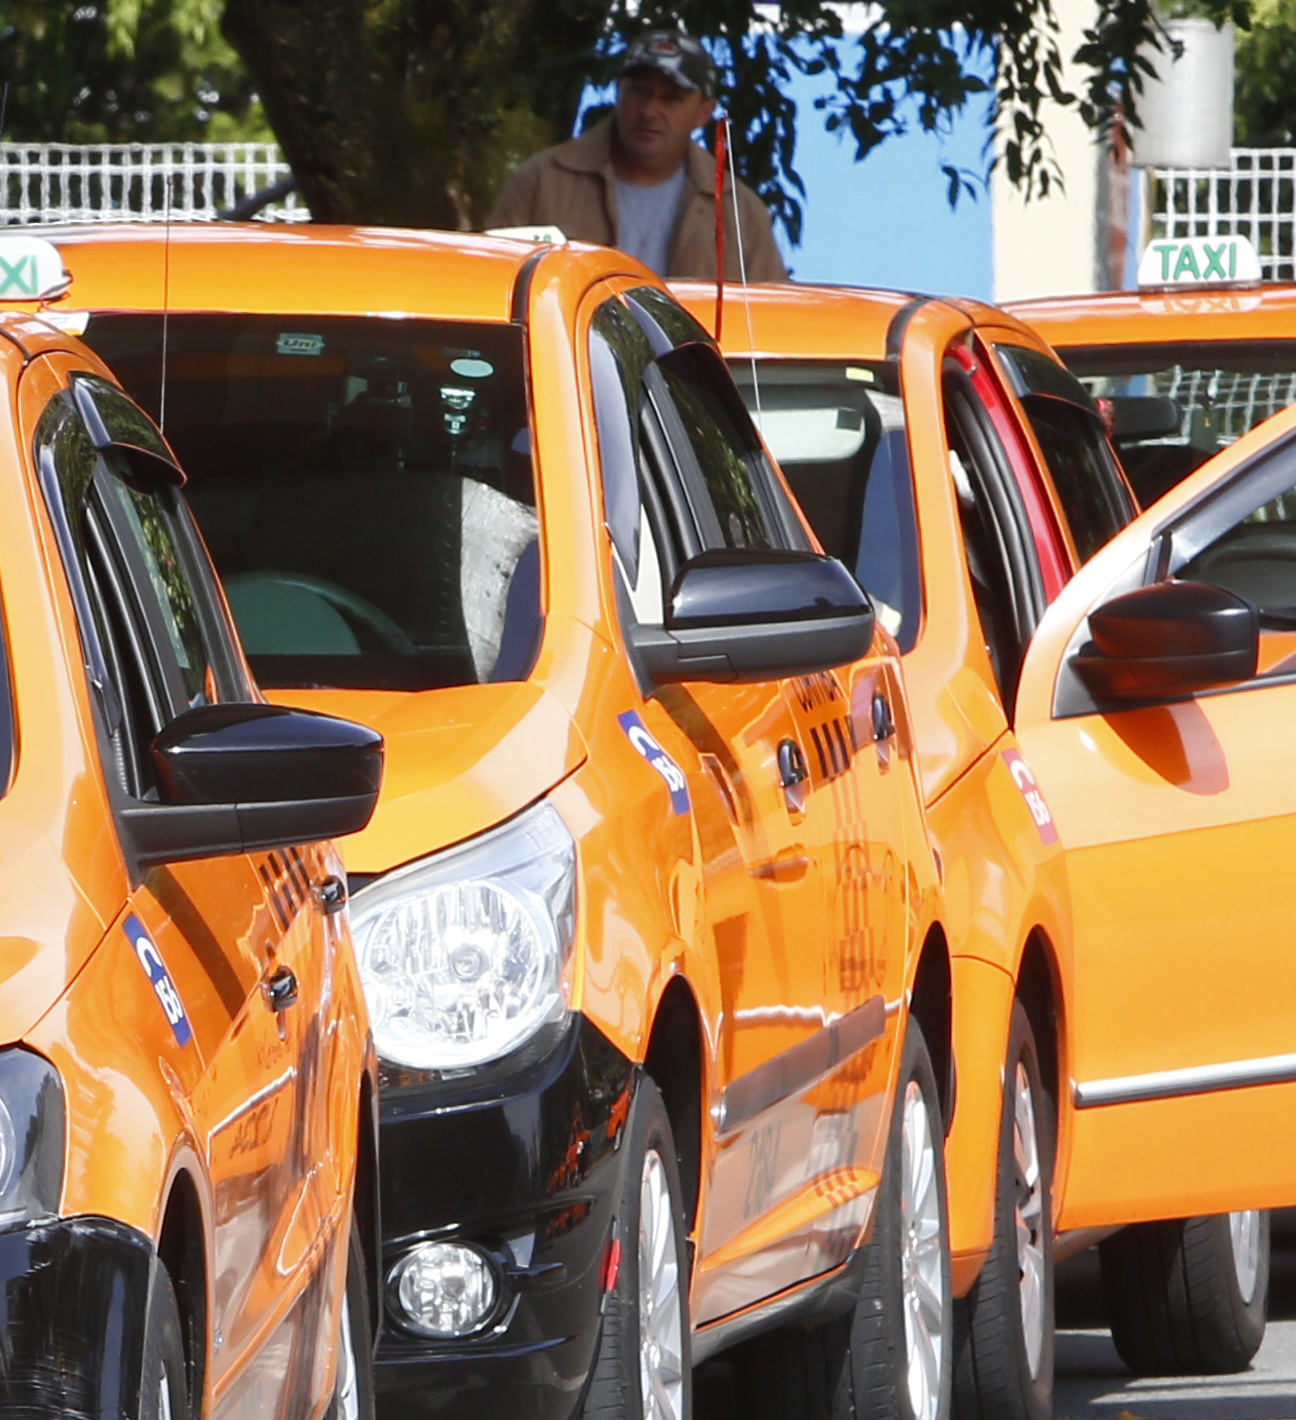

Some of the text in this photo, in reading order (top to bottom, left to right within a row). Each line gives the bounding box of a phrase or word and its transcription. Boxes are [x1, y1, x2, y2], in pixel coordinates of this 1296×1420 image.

[1153, 242, 1237, 281] TAXI
[651, 755, 685, 792] 156
[1025, 789, 1051, 826] 156
[154, 975, 184, 1025] 156
